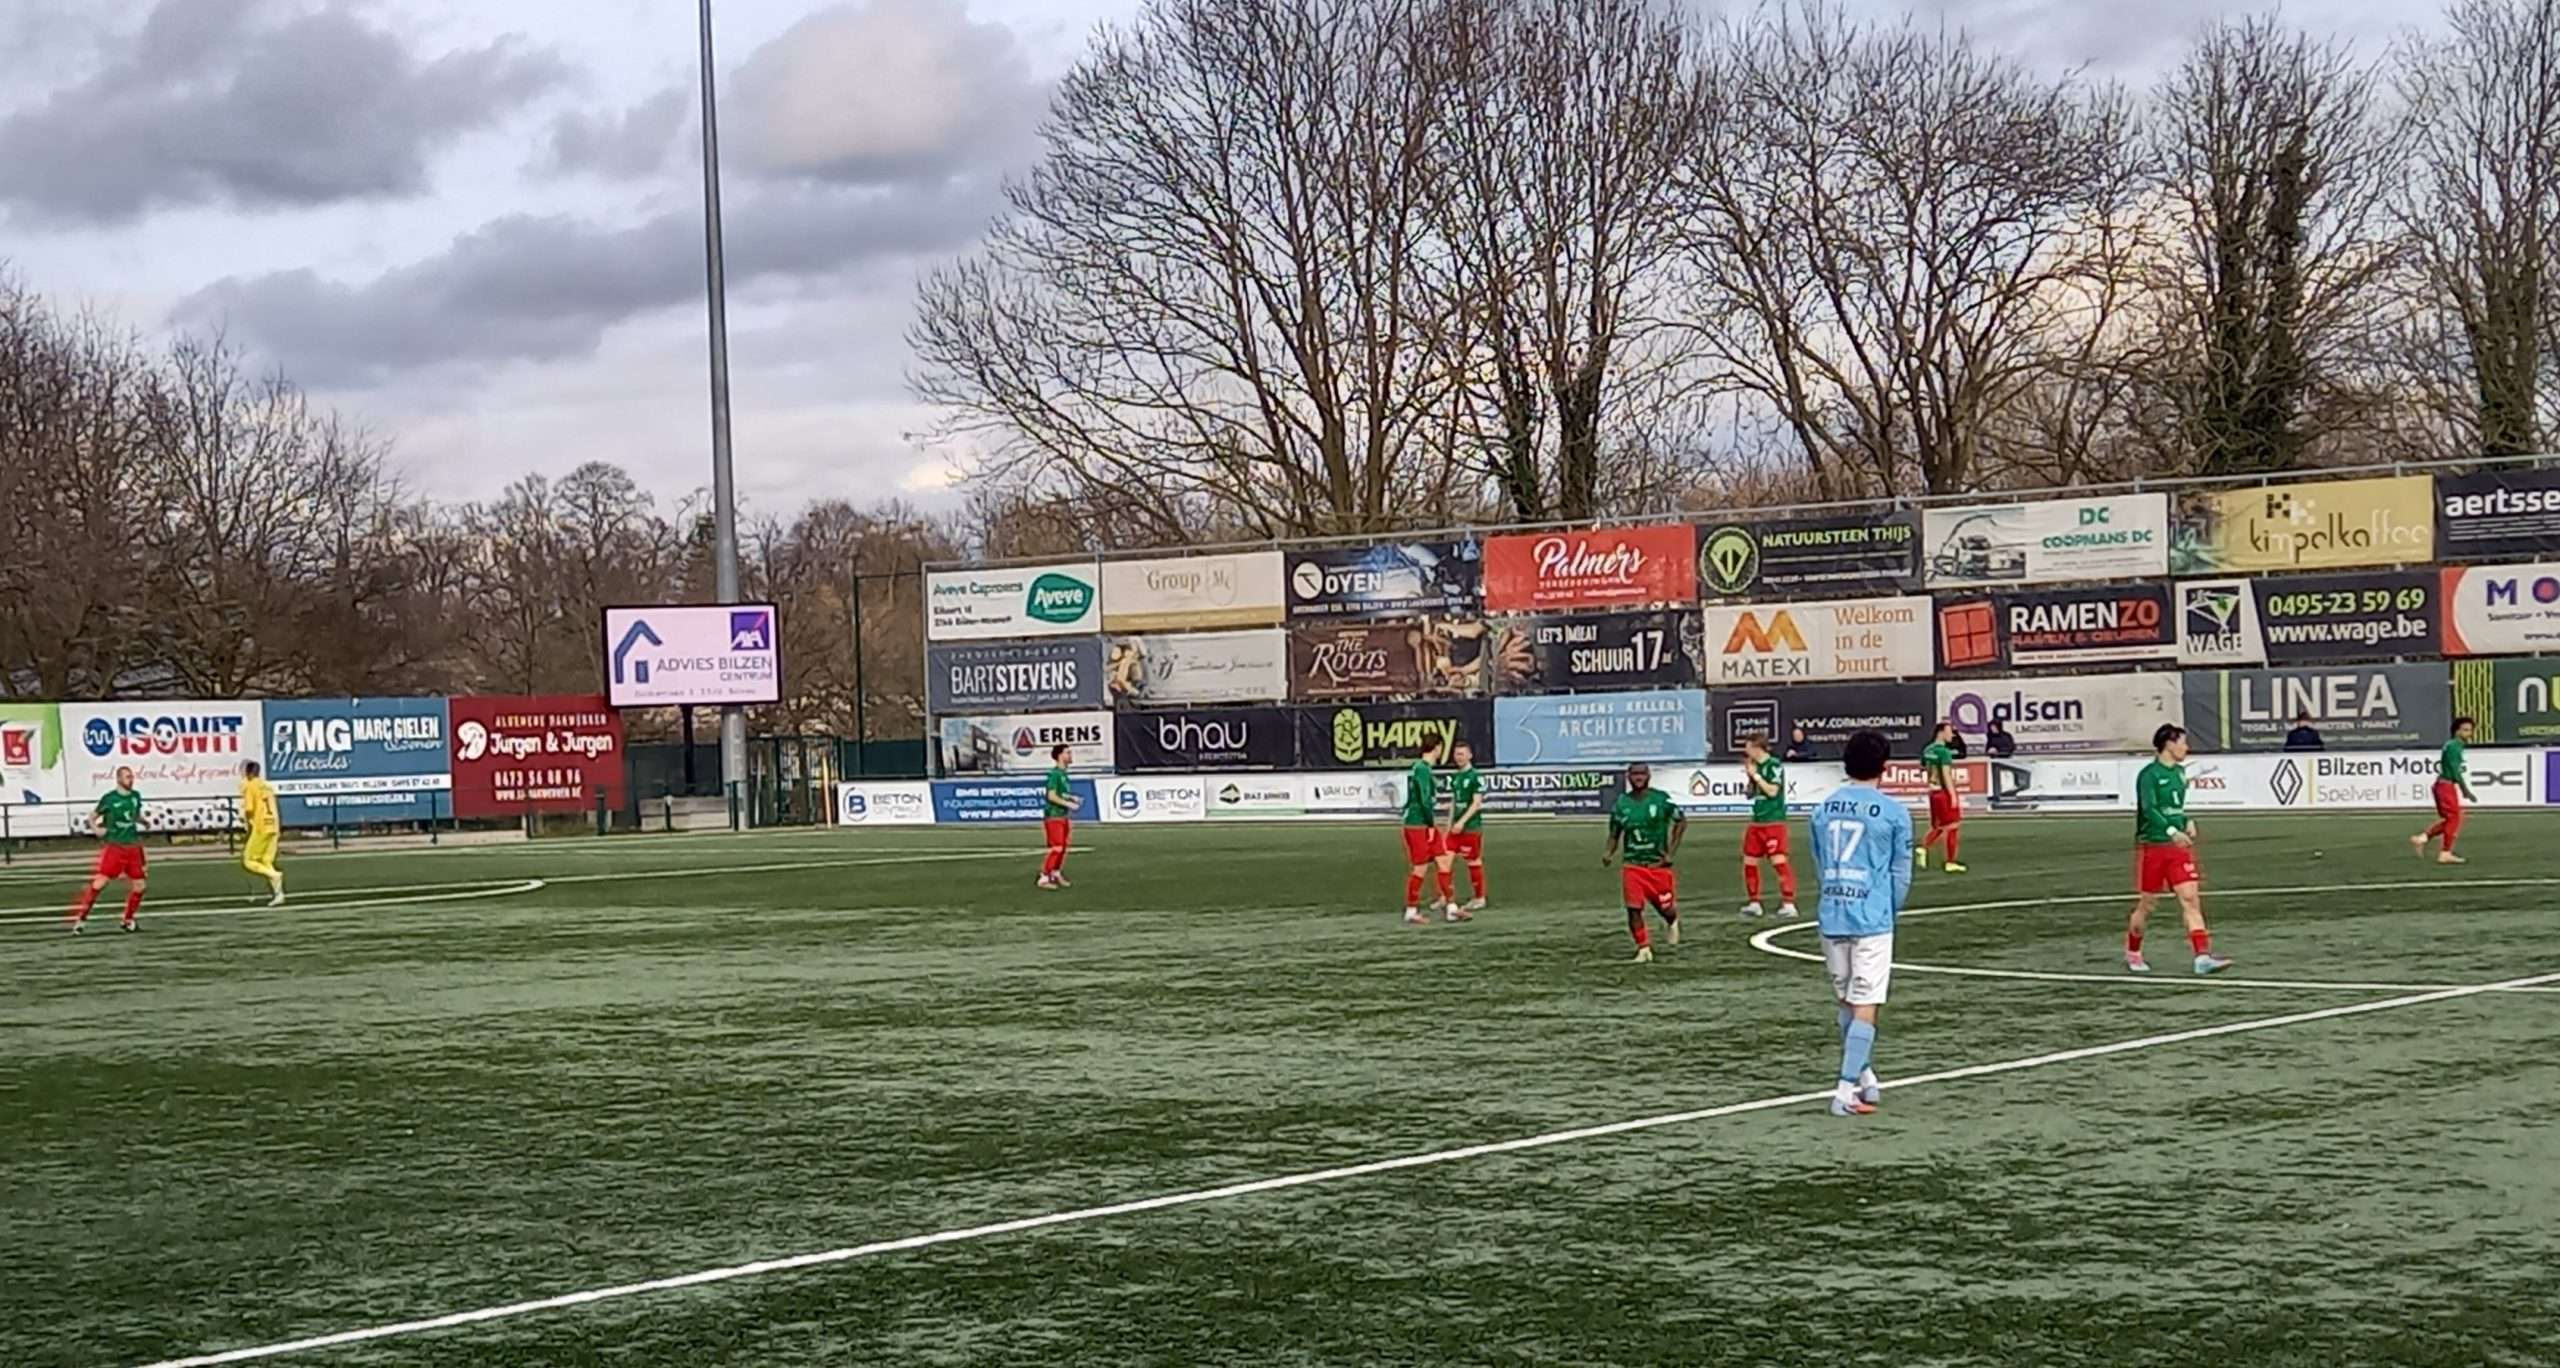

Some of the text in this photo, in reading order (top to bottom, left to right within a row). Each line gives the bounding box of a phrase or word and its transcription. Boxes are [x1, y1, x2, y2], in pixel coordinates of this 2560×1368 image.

[2079, 508, 2109, 525] DC
[1762, 525, 1911, 547] NATUURSTEEN THIJS
[2042, 530, 2152, 548] COOPMANS DC
[1533, 537, 1648, 584] Palmers
[1147, 571, 1200, 593] Group
[1325, 572, 1381, 594] OYEN
[1034, 588, 1084, 607] Aveve
[2268, 588, 2426, 617] 0495-23 59 69
[1834, 606, 1914, 626] Welkom
[2010, 602, 2160, 632] RAMENZO
[732, 630, 764, 649] AXA
[1836, 629, 1883, 650] in de
[2268, 614, 2428, 645] www.wage.be
[1334, 636, 1364, 651] THE
[2186, 633, 2242, 655] WAGE
[656, 655, 772, 672] ADVIES BILZEN
[1722, 657, 1810, 679] MATEXI
[1835, 654, 1889, 674] buurt
[719, 672, 772, 682] CENTRUM
[951, 661, 1077, 694] BARTSTEVENS
[2240, 674, 2398, 721] LINEA
[118, 716, 242, 755] ISOWIT
[353, 718, 393, 740] MARC
[394, 717, 439, 739] GIELEN
[1040, 726, 1101, 743] ERENS
[1159, 716, 1248, 750] bhau
[1558, 715, 1685, 738] ARCHITECTEN
[490, 731, 613, 760] Jurgen & Jurgen
[2318, 756, 2467, 776] Bilzen Motos
[872, 793, 922, 804] BETON
[1146, 788, 1200, 802] BETON
[2317, 784, 2380, 802] Spelver
[1827, 819, 1865, 864] 17
